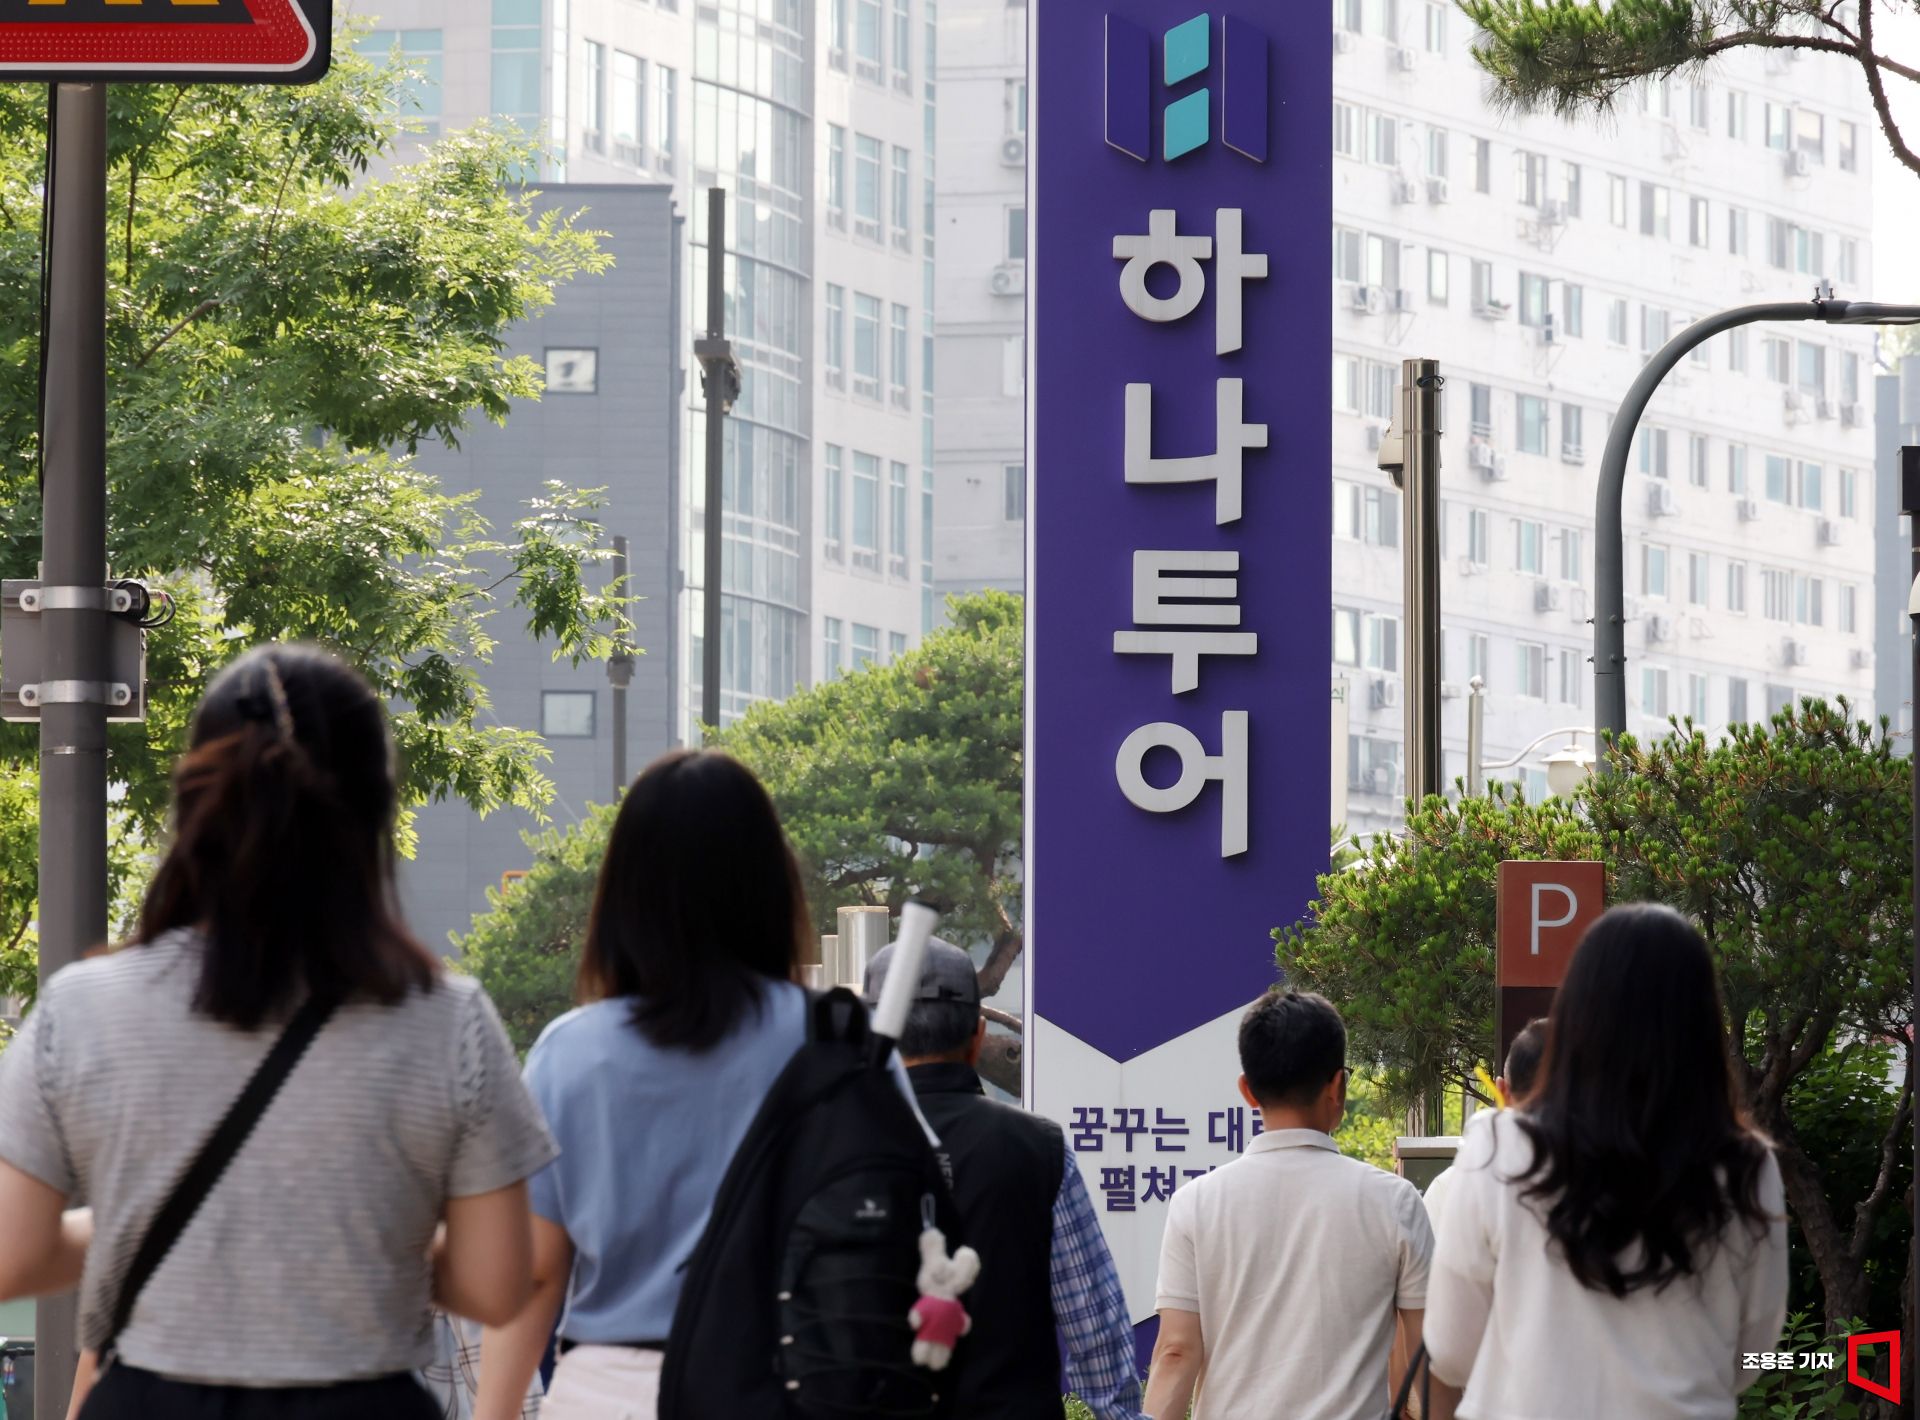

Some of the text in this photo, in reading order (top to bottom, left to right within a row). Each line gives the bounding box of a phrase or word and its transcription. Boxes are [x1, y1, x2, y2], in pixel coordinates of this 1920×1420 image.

[1112, 207, 1269, 858] 하나투어
[1530, 882, 1578, 955] P
[1069, 1107, 1190, 1153] 꿈꾸는
